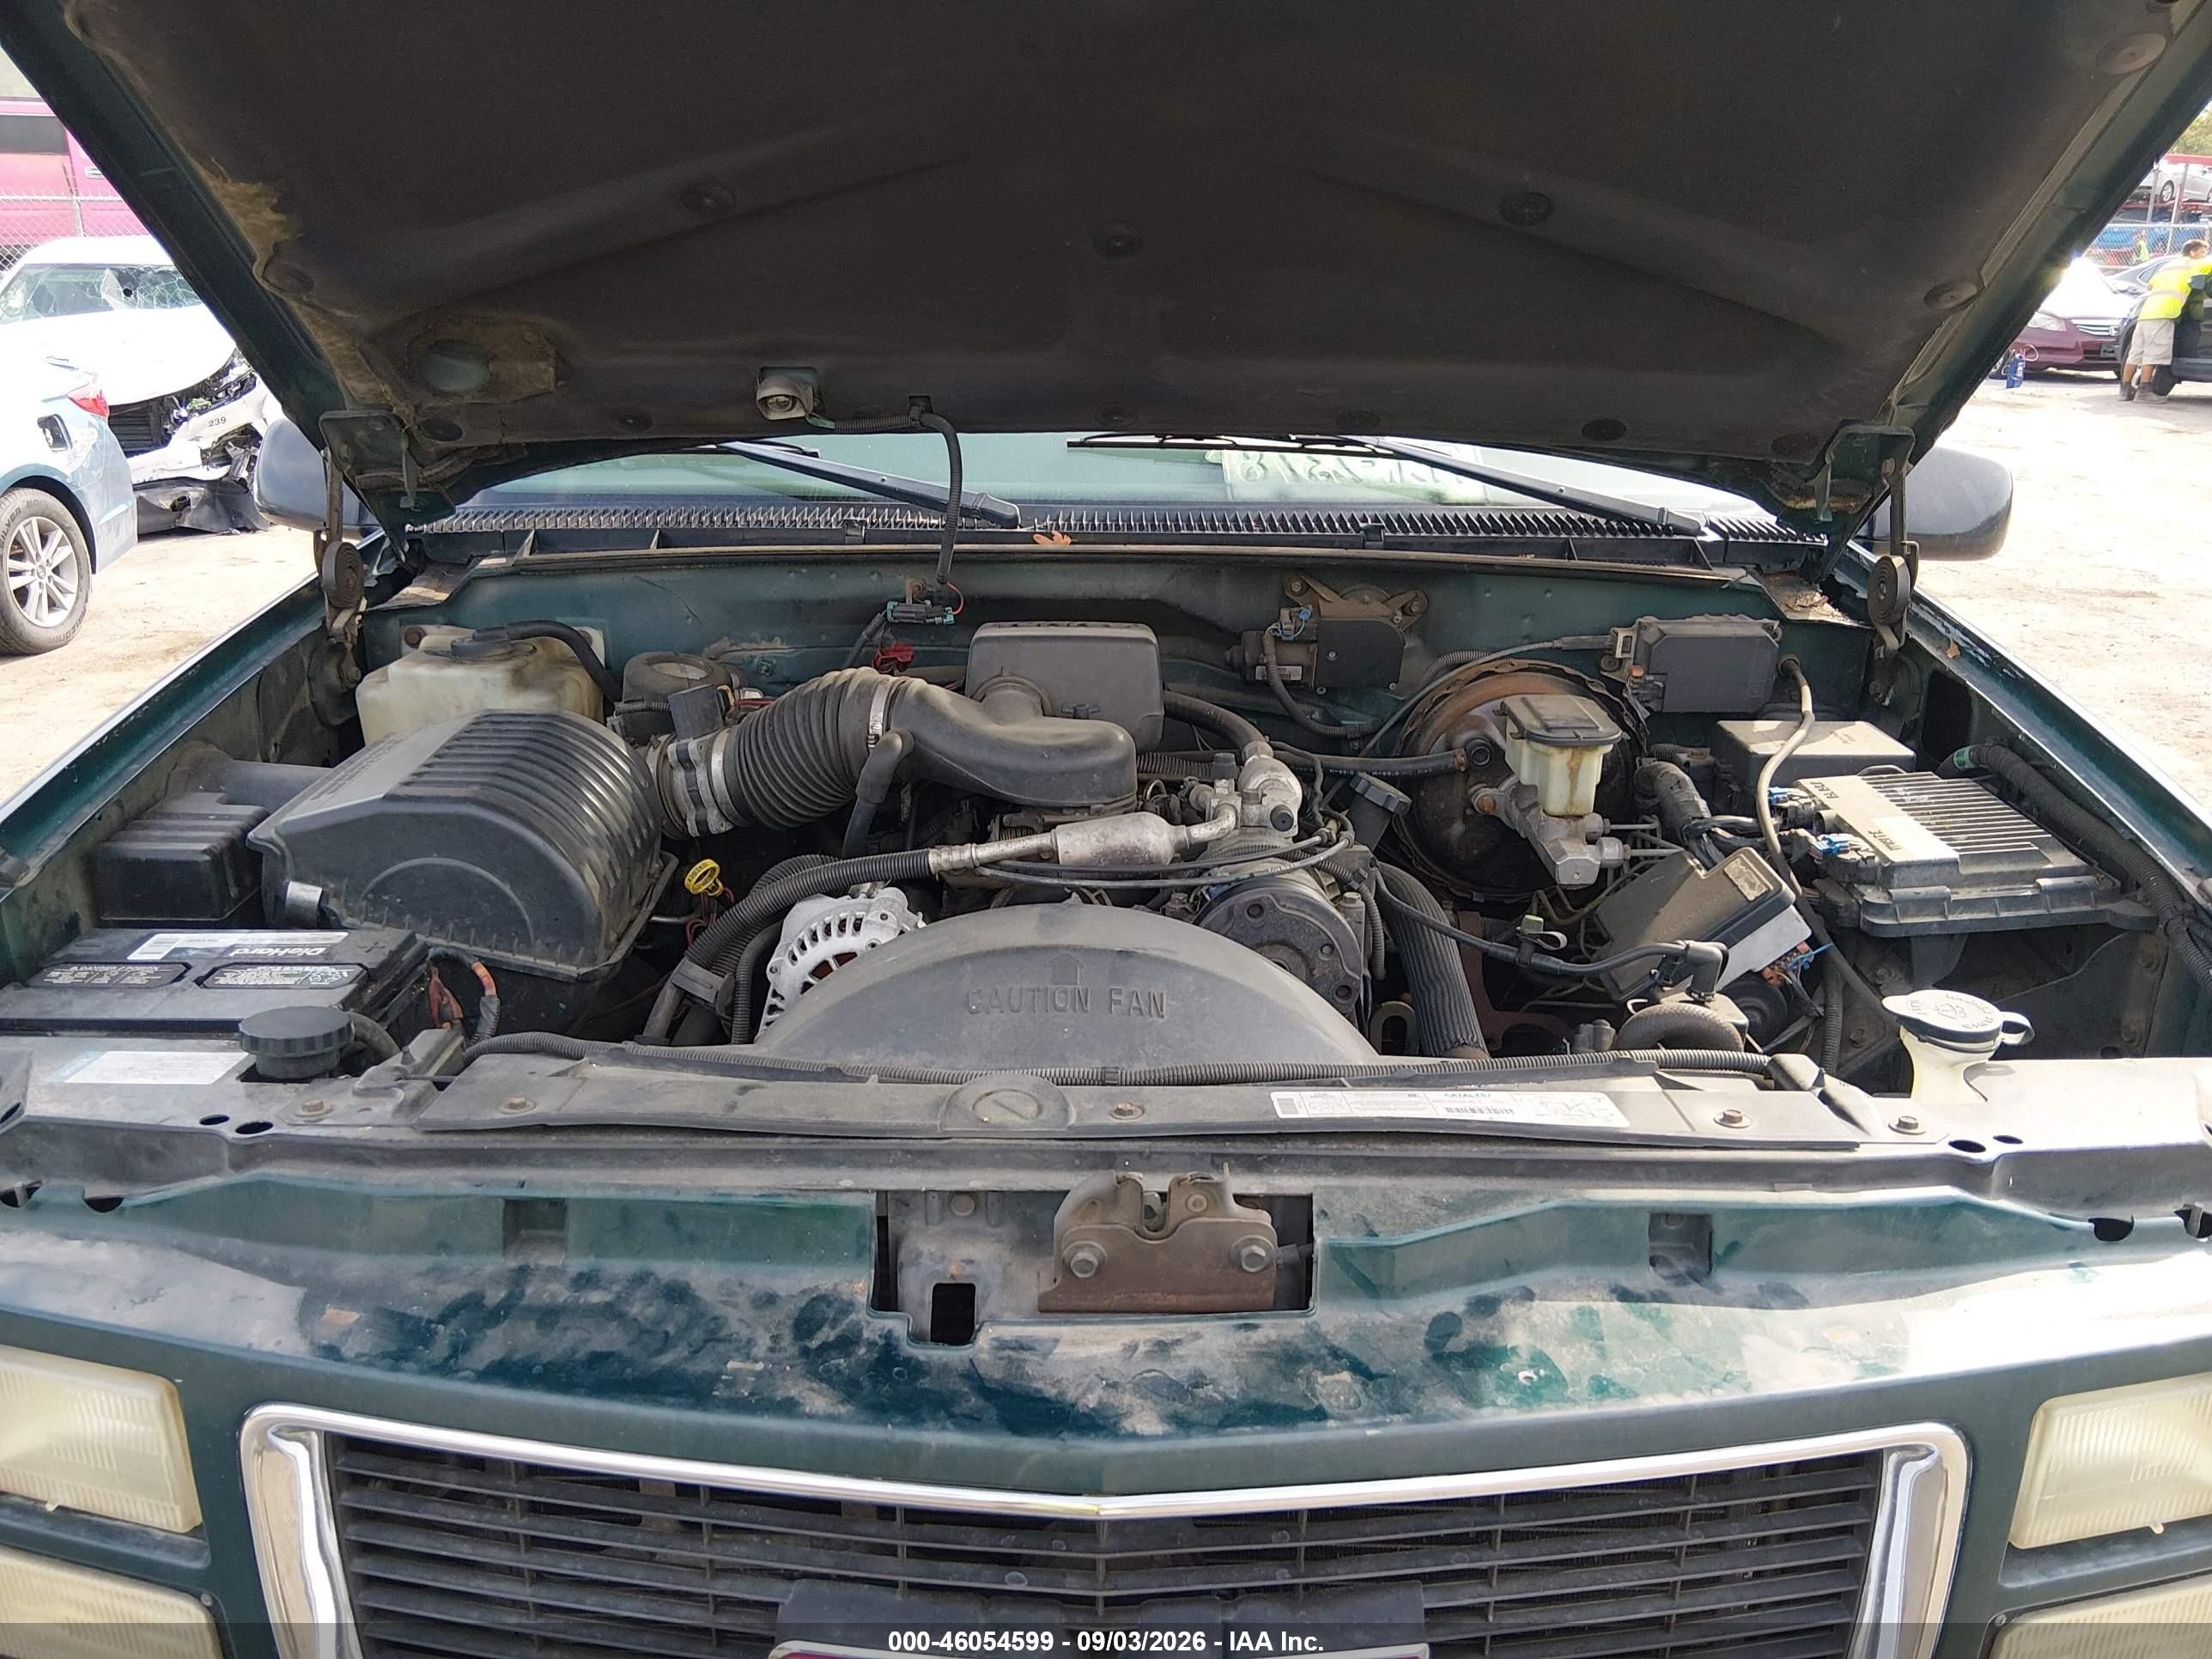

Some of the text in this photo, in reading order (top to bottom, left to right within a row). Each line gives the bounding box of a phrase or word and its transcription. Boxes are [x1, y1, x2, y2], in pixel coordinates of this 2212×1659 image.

[208, 416, 227, 428] 239
[228, 946, 326, 957] DieHard
[967, 987, 1169, 1019] CAUTION FAN
